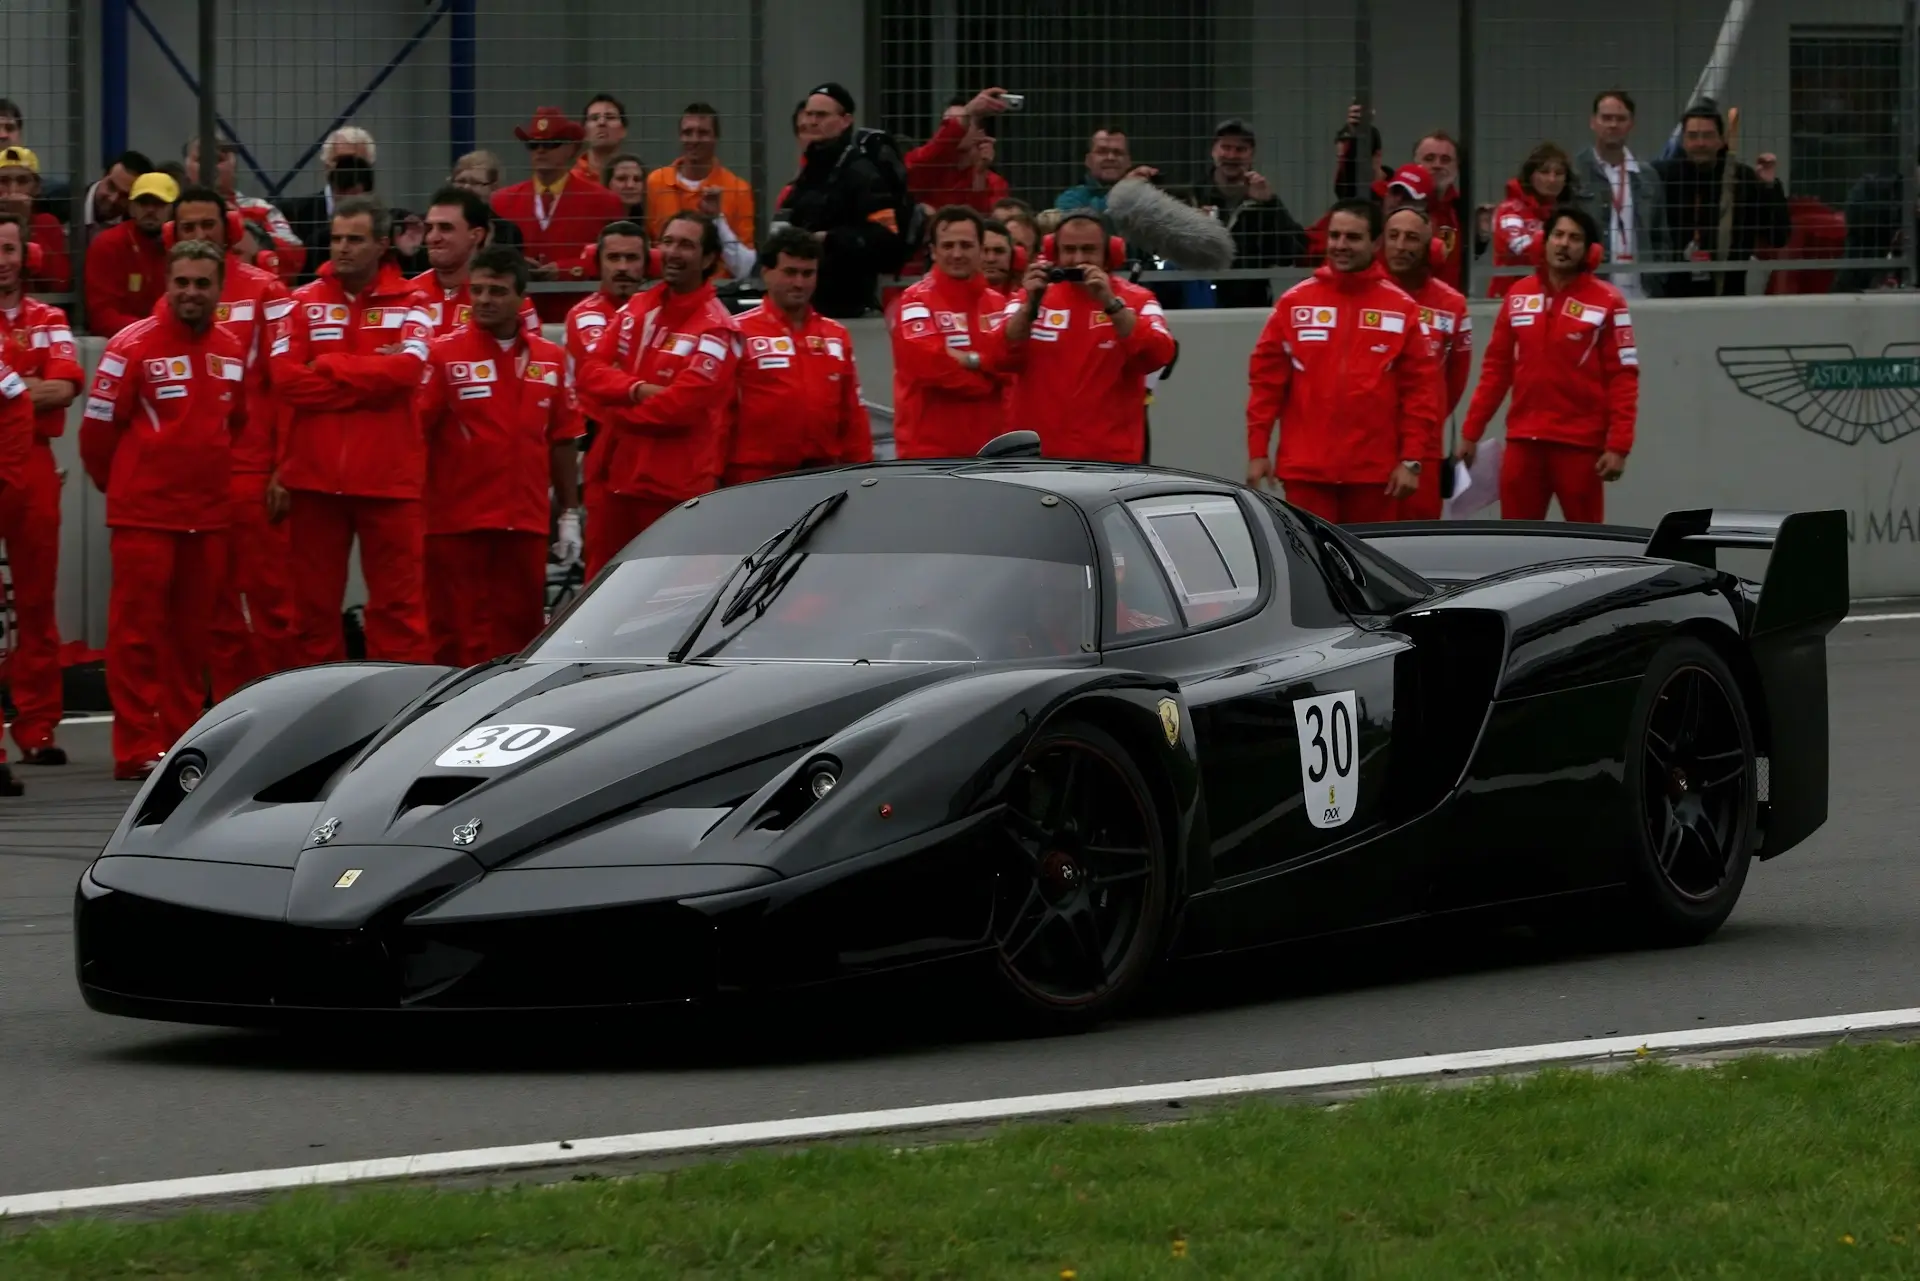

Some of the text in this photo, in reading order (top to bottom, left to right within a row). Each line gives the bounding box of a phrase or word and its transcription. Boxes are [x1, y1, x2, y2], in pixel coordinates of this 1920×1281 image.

[1809, 365, 1862, 386] ASTON
[1866, 508, 1920, 544] MA
[455, 726, 551, 752] 30
[1305, 700, 1353, 783] 30
[1323, 806, 1341, 820] FXX
